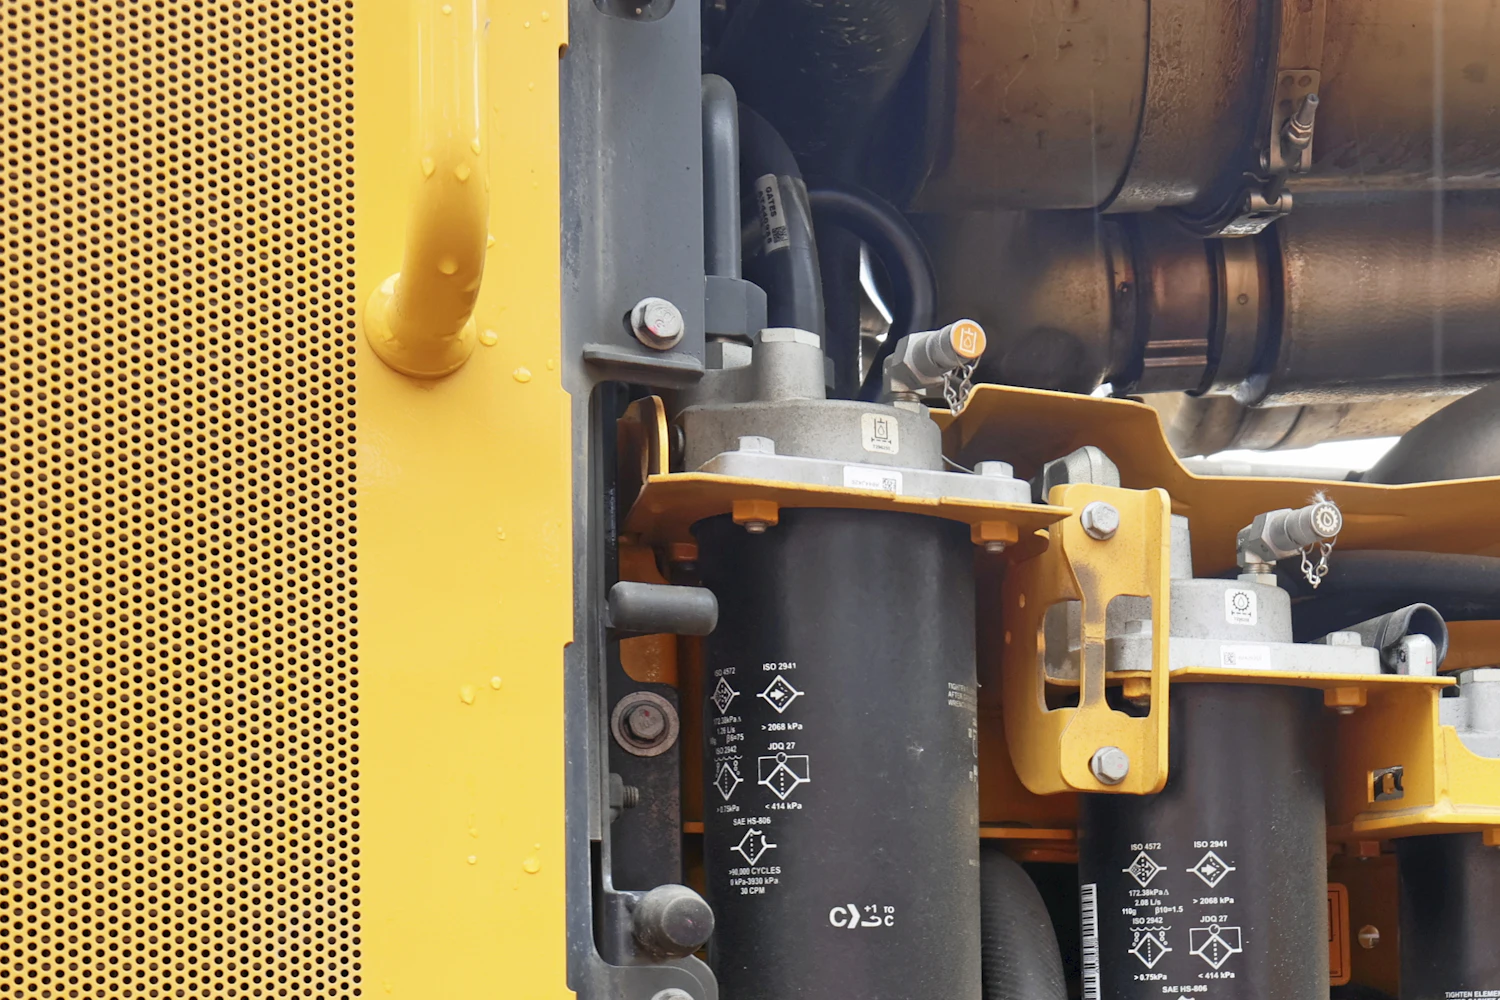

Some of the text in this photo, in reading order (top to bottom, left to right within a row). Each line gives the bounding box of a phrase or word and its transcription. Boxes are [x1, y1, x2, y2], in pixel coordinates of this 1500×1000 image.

[766, 186, 777, 217] GATES
[762, 662, 796, 671] ISO 2941
[767, 723, 786, 731] 2068
[767, 742, 796, 750] JDQ 27
[787, 802, 803, 810] kPa
[733, 817, 772, 826] SAE HS-806
[1130, 843, 1143, 851] ISO
[751, 866, 781, 875] CYCLES
[764, 877, 779, 885] kPa
[740, 886, 765, 895] 30 CPM
[884, 905, 895, 913] TO
[1220, 971, 1235, 979] kPa
